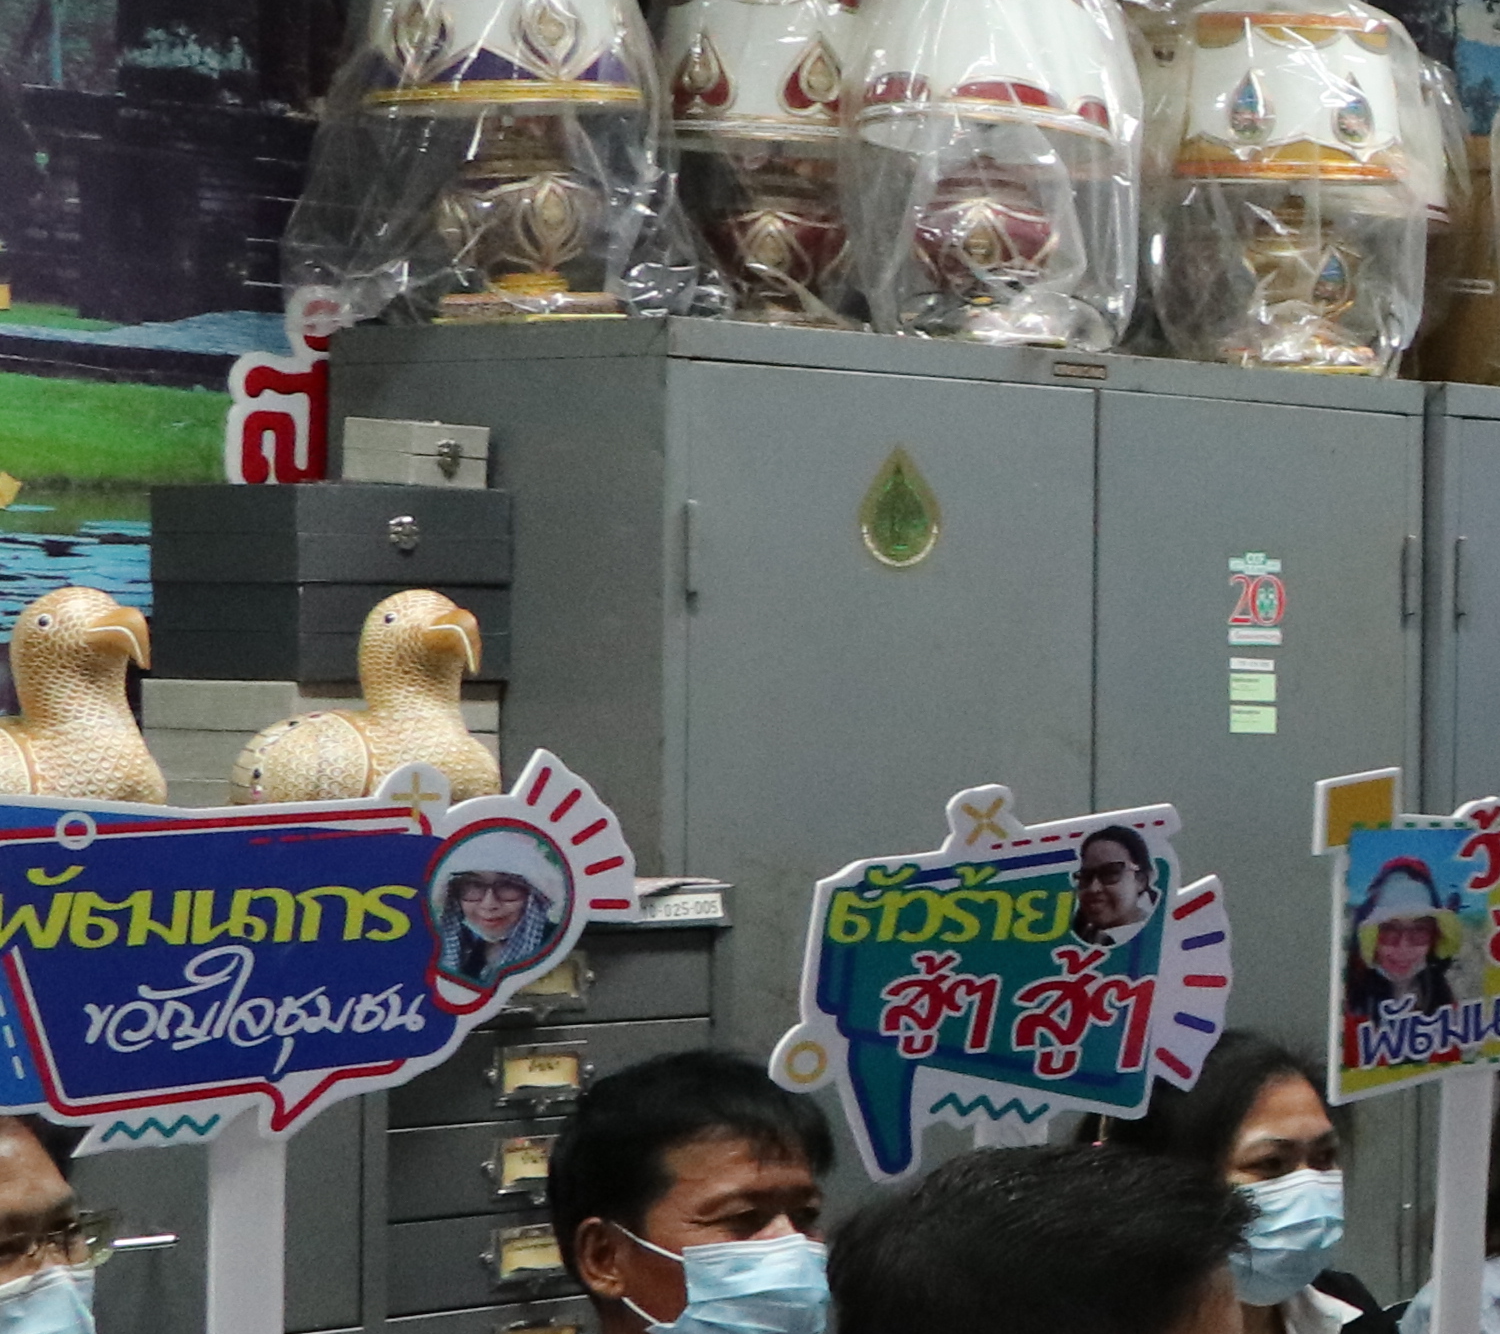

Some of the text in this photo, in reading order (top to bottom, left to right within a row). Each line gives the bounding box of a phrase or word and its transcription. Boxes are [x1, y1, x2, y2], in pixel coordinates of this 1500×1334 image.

[0, 864, 417, 952] พัฒนากร
[827, 863, 1075, 945] ตัวร้าย
[83, 944, 427, 1077] ขวัญใจชุมชน
